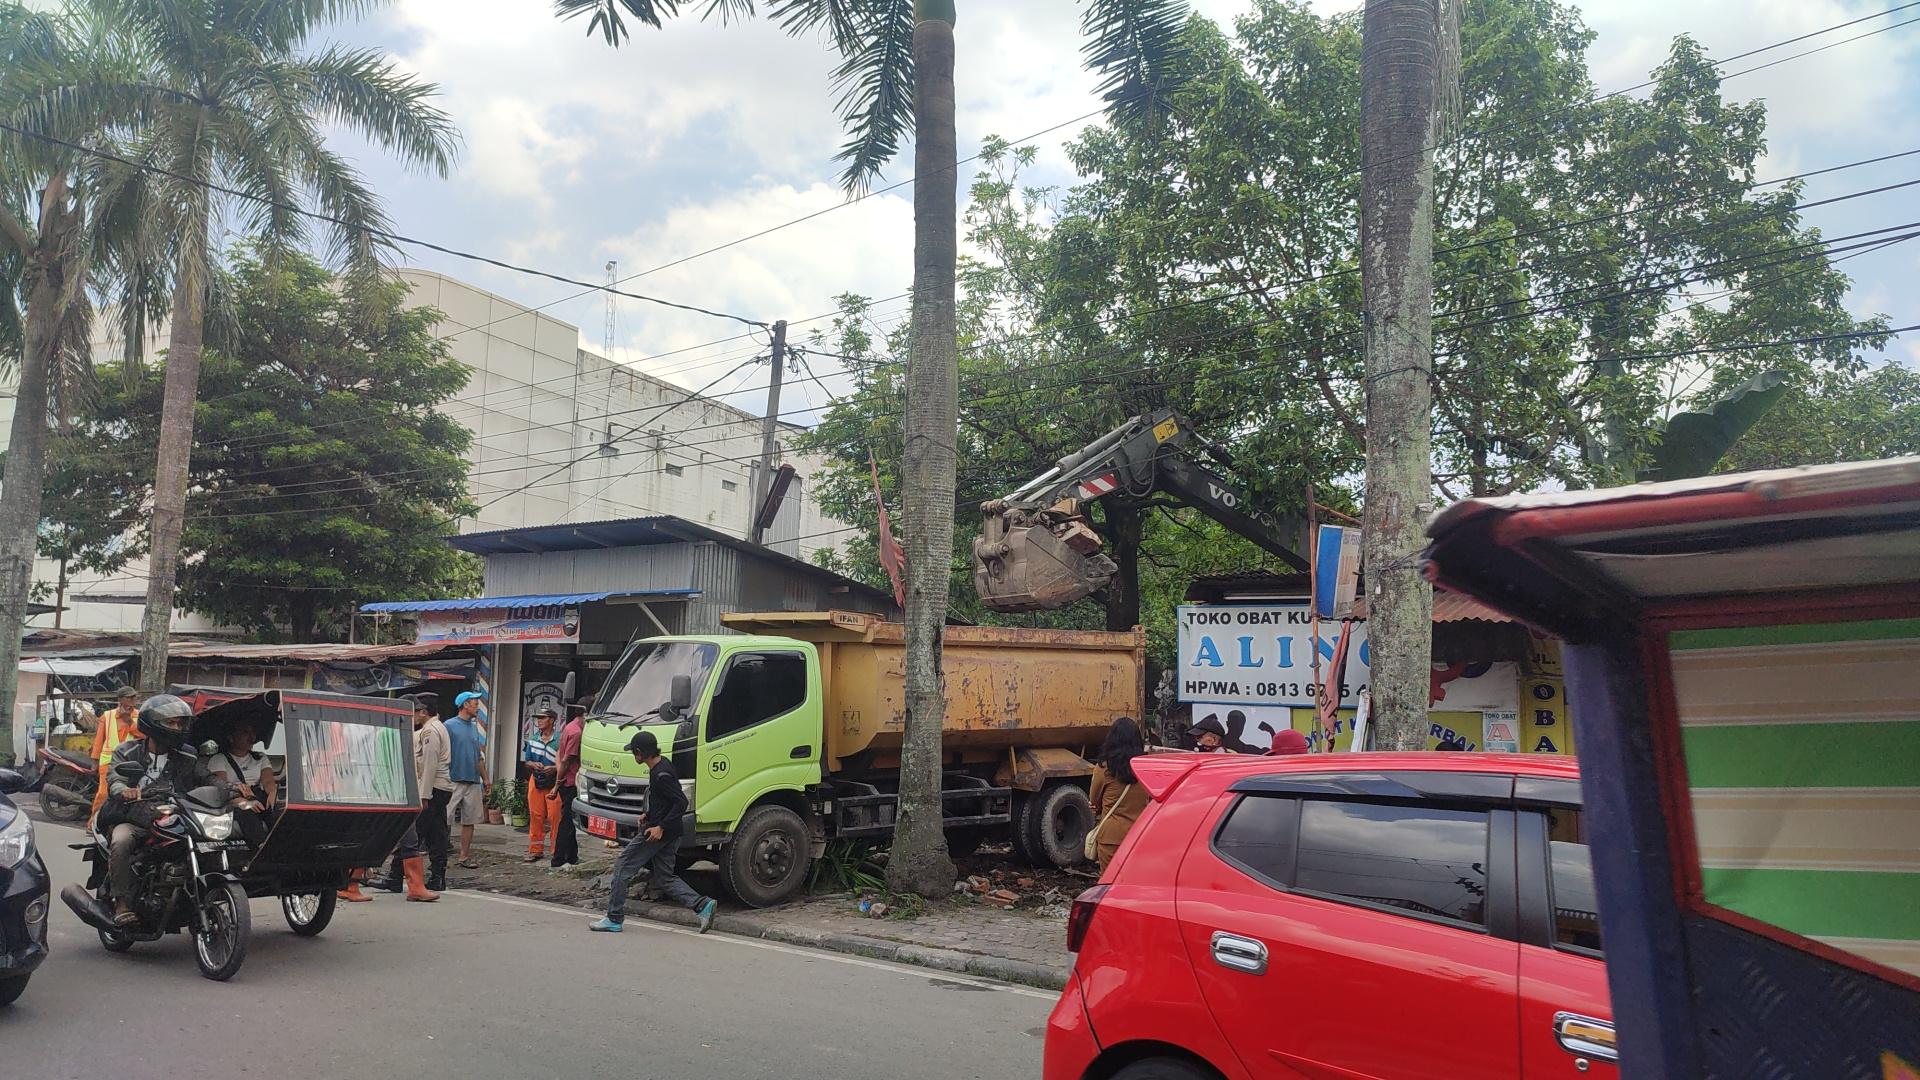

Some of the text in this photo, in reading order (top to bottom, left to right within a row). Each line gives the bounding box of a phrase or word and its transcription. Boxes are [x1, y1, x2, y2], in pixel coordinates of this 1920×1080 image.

[1187, 612, 1232, 625] TOKO
[1237, 612, 1281, 625] OBAT
[1185, 681, 1240, 696] HP/WA
[1256, 682, 1299, 697] 0813
[612, 760, 620, 769] 50
[712, 761, 727, 772] 50
